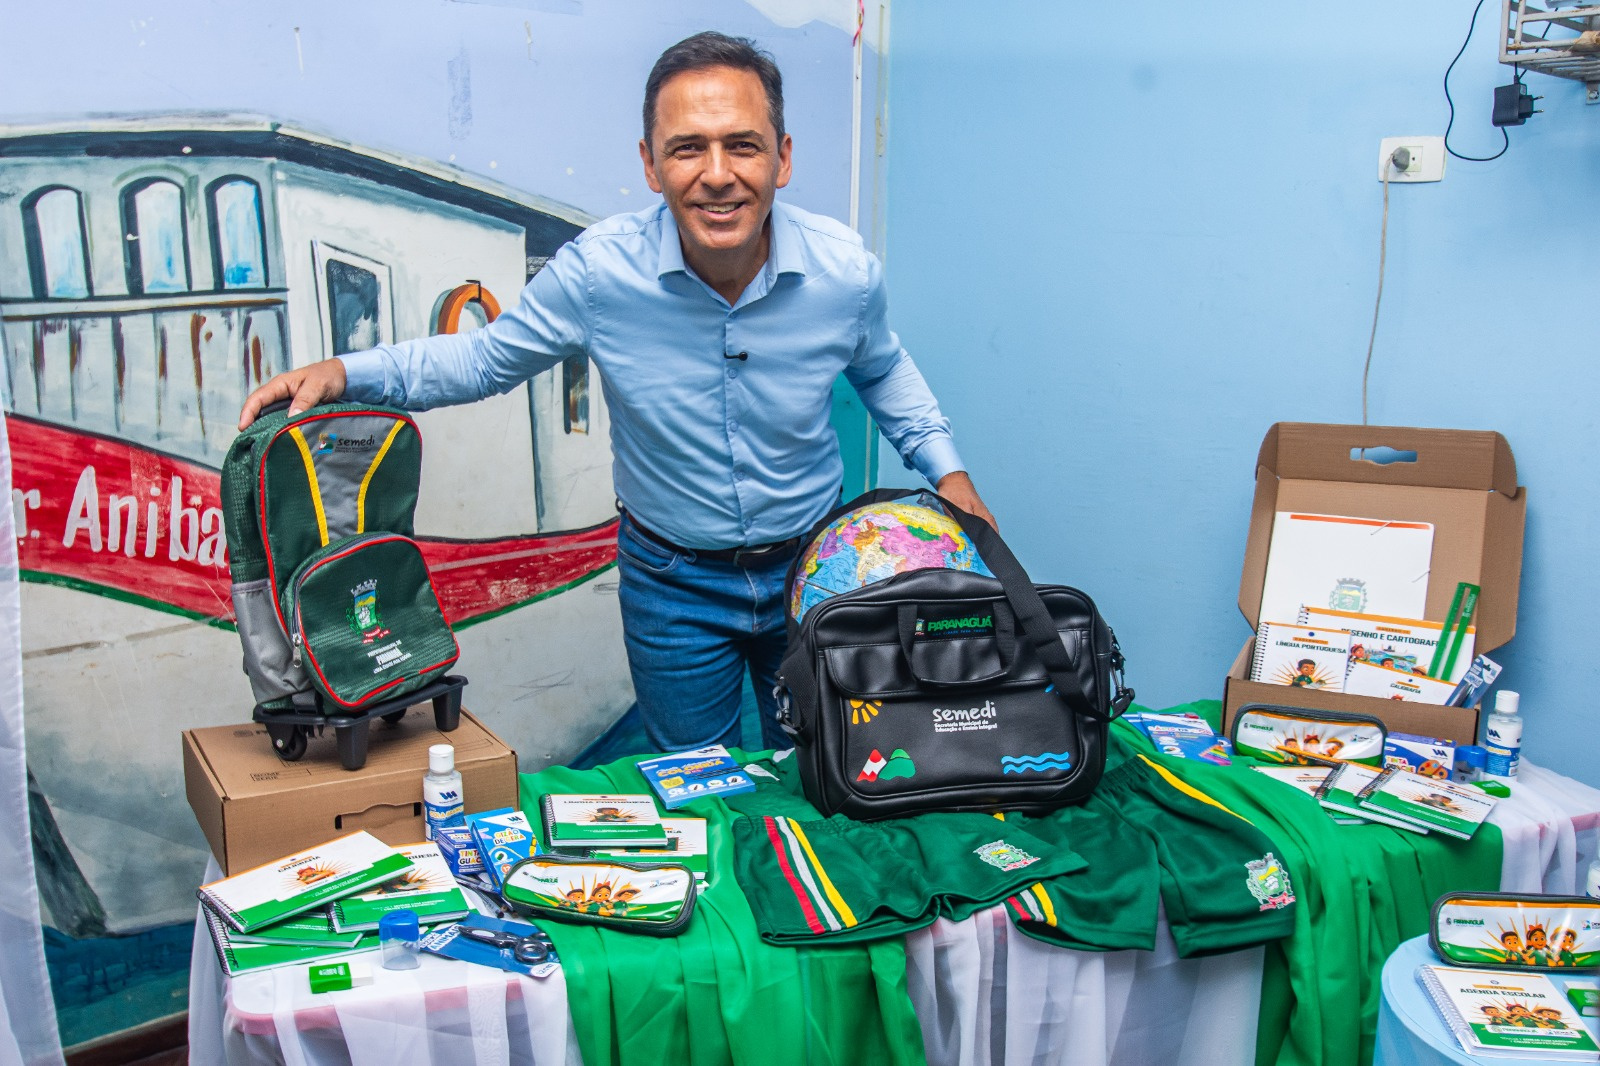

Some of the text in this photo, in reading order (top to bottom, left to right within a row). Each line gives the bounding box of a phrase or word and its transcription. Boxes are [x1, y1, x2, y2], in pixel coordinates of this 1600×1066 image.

[62, 465, 229, 568] Aniba
[927, 615, 993, 632] PARANAGUÁ
[1341, 628, 1378, 640] SENHO
[1301, 643, 1347, 654] PORTUGUESA
[459, 857, 482, 865] GUAC
[1460, 988, 1500, 996] AGENDA
[1501, 990, 1546, 999] ESCOLAR
